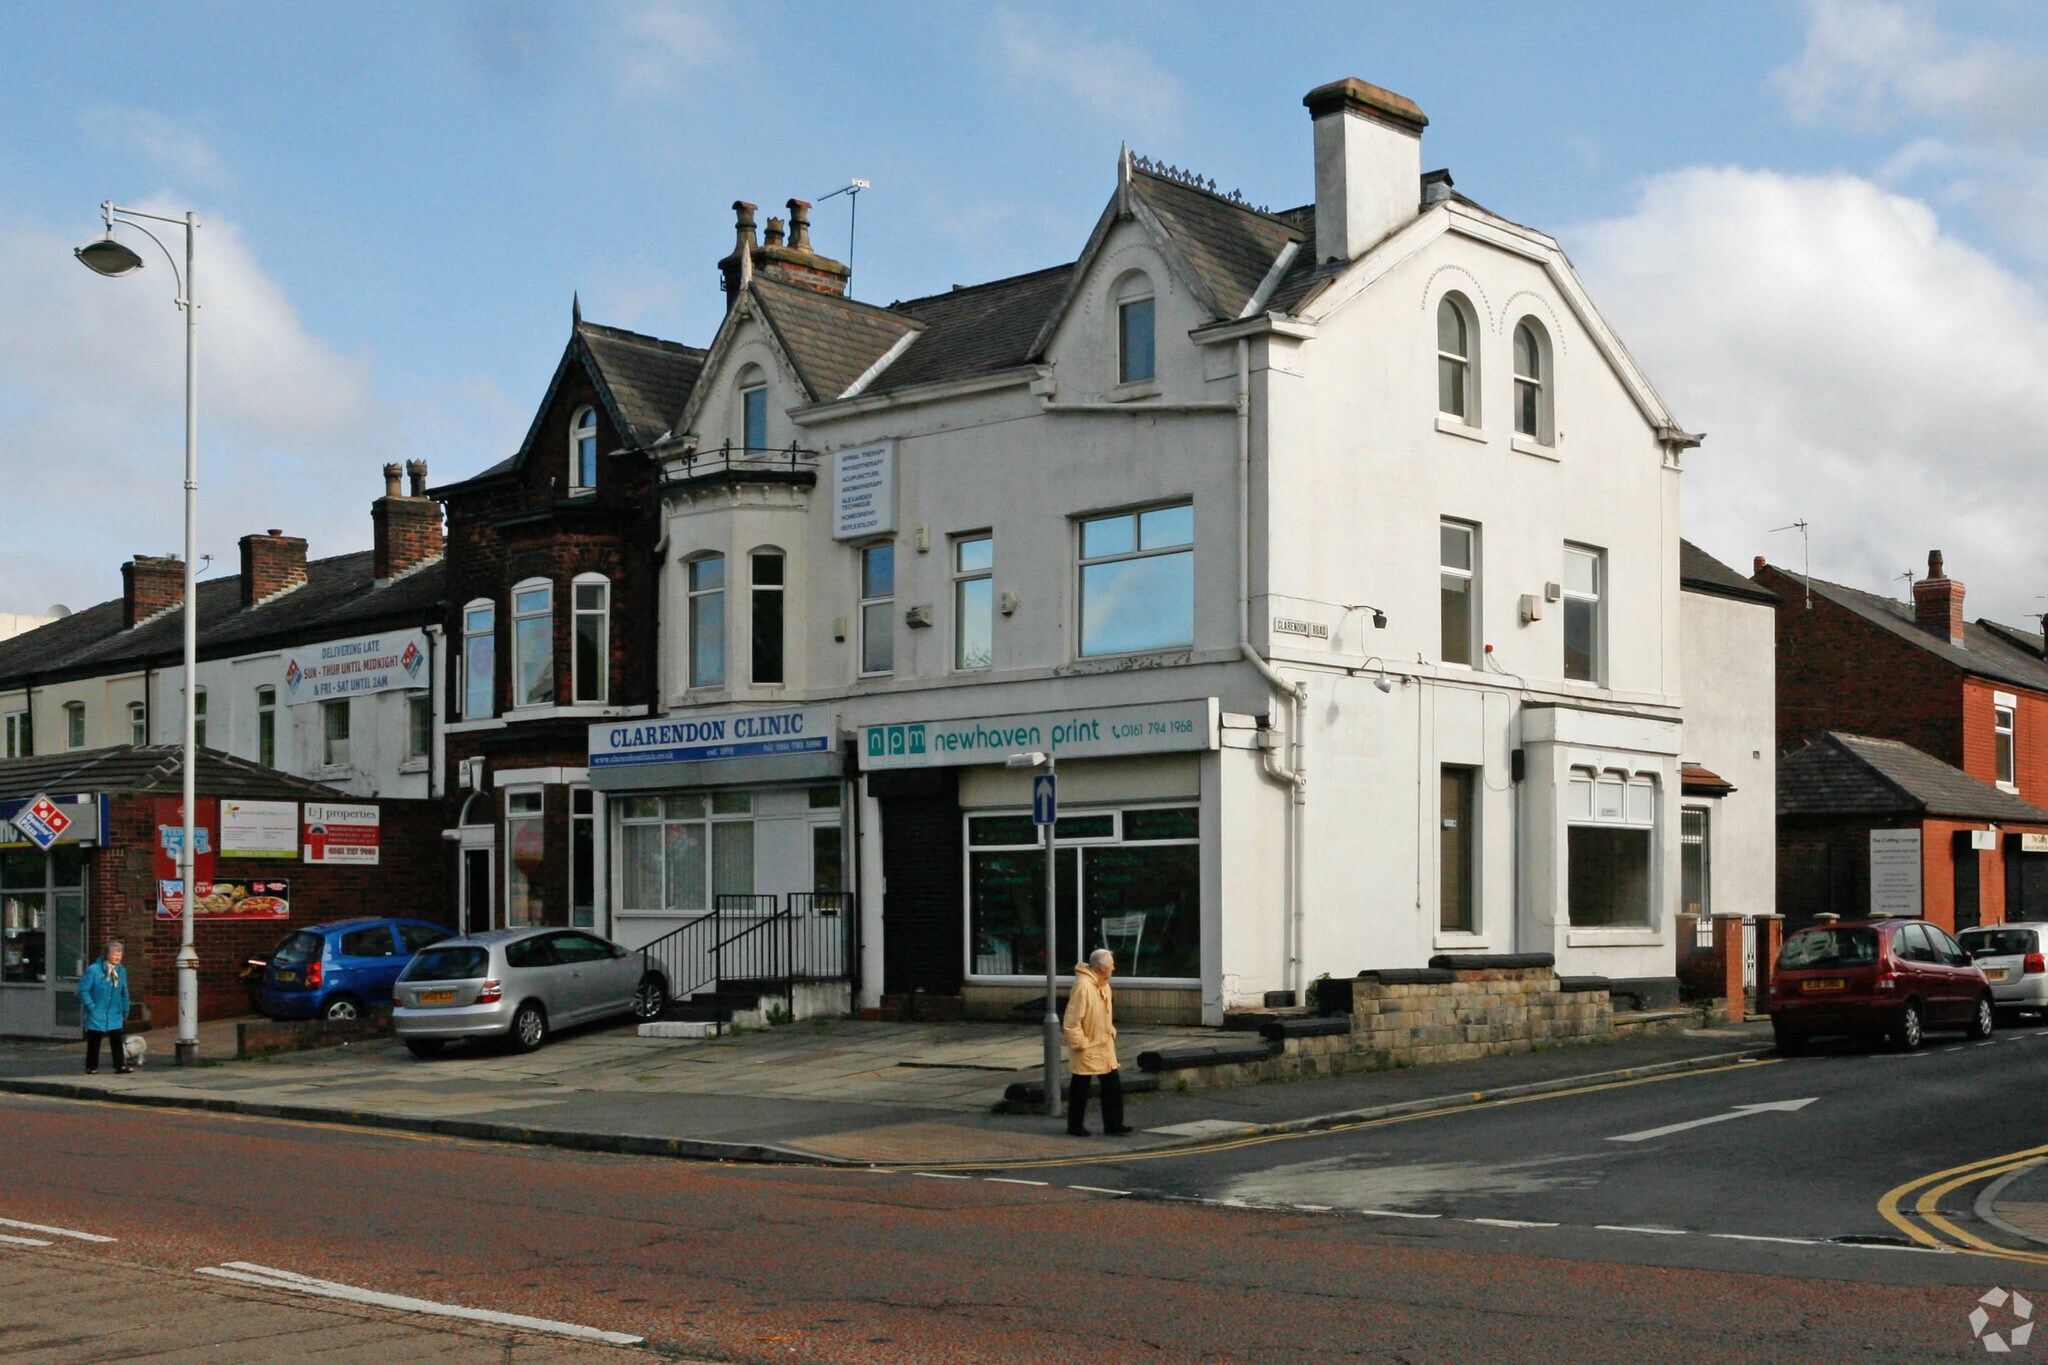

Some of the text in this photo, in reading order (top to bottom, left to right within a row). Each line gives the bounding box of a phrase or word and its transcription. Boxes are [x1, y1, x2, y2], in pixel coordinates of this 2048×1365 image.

[862, 449, 885, 457] THERAPY
[842, 460, 884, 472] PHYSIOTHERAPY
[842, 471, 879, 482] ACUPUNCTURE
[842, 481, 883, 492] AROMATHERAPY
[842, 493, 873, 503] ALEXANDER
[842, 501, 871, 511] TECHNIQUE
[841, 510, 876, 520] HOMEOPATHY
[841, 520, 878, 531] REFLEXOLOGY
[1278, 620, 1326, 636] CLARENDON ROAD
[322, 640, 380, 659] DELIVERING LATE
[304, 667, 317, 679] SUN
[322, 664, 340, 677] THUR
[341, 661, 361, 674] UNTIL
[363, 655, 399, 671] MIDNIGHT
[314, 685, 319, 696] &
[321, 682, 331, 695] FRI
[337, 680, 350, 693] SAT
[350, 677, 371, 691] UNTIL
[372, 675, 388, 688] 2AM
[610, 713, 804, 748] CLARENDON CLINIC
[935, 724, 1041, 751] newhaven
[1052, 719, 1099, 752] print
[1121, 724, 1143, 737] 0161
[1148, 722, 1166, 735] 794
[1170, 720, 1193, 734] 1968
[326, 809, 377, 820] properties
[20, 813, 53, 840] Domino's Pizza
